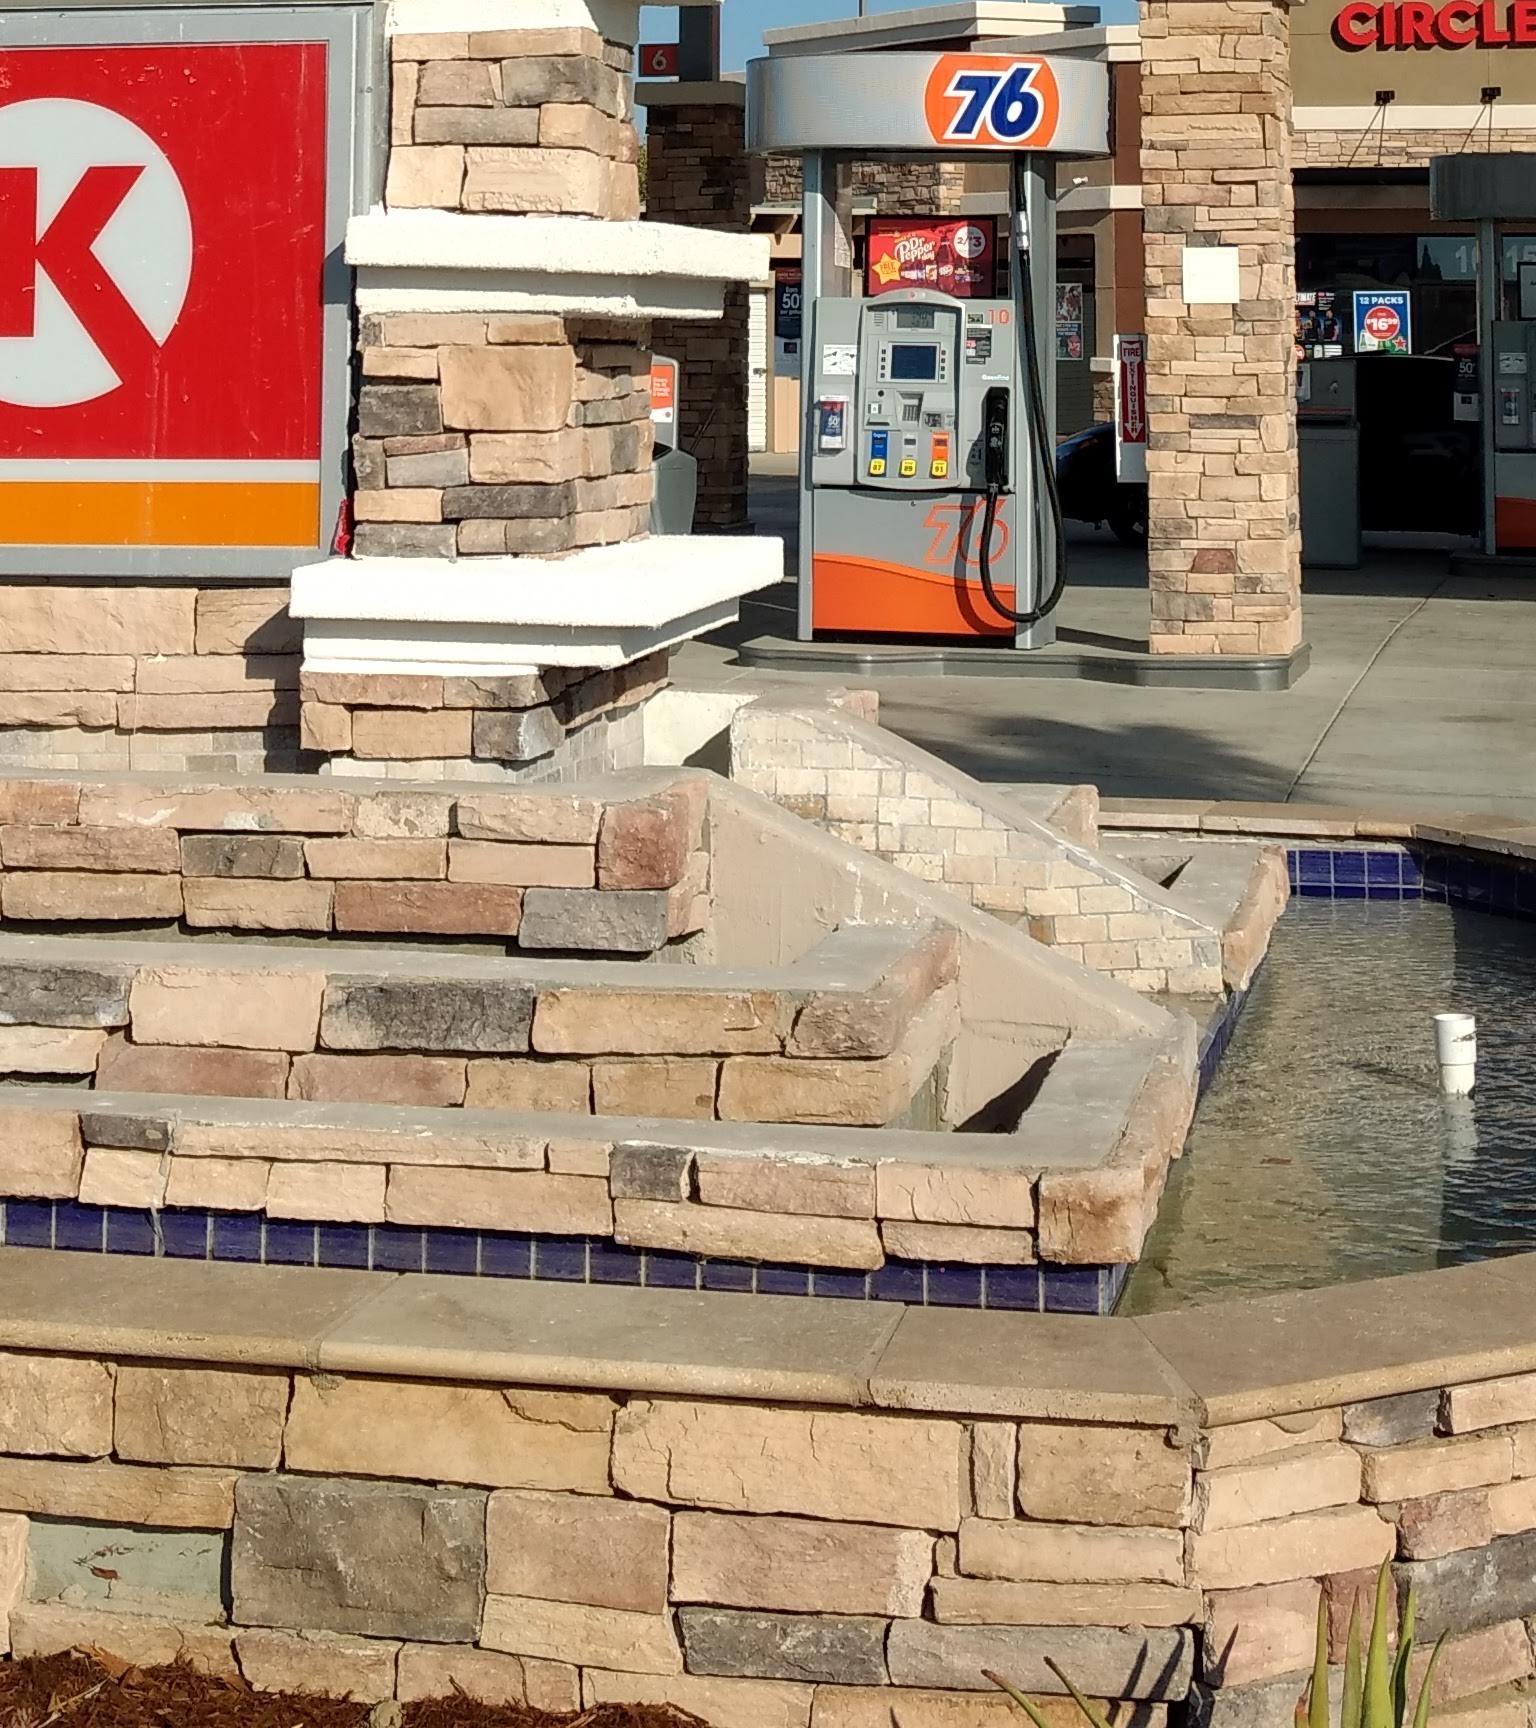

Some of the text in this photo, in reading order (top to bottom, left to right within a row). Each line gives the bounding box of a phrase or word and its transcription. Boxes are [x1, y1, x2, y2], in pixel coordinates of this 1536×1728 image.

[652, 49, 667, 71] 6
[942, 61, 1045, 143] 76
[894, 241, 936, 263] Pepper
[1359, 296, 1404, 305] 12 PACKS
[988, 308, 1010, 325] 10
[1123, 347, 1141, 357] FIRE
[922, 494, 1010, 567] 76
